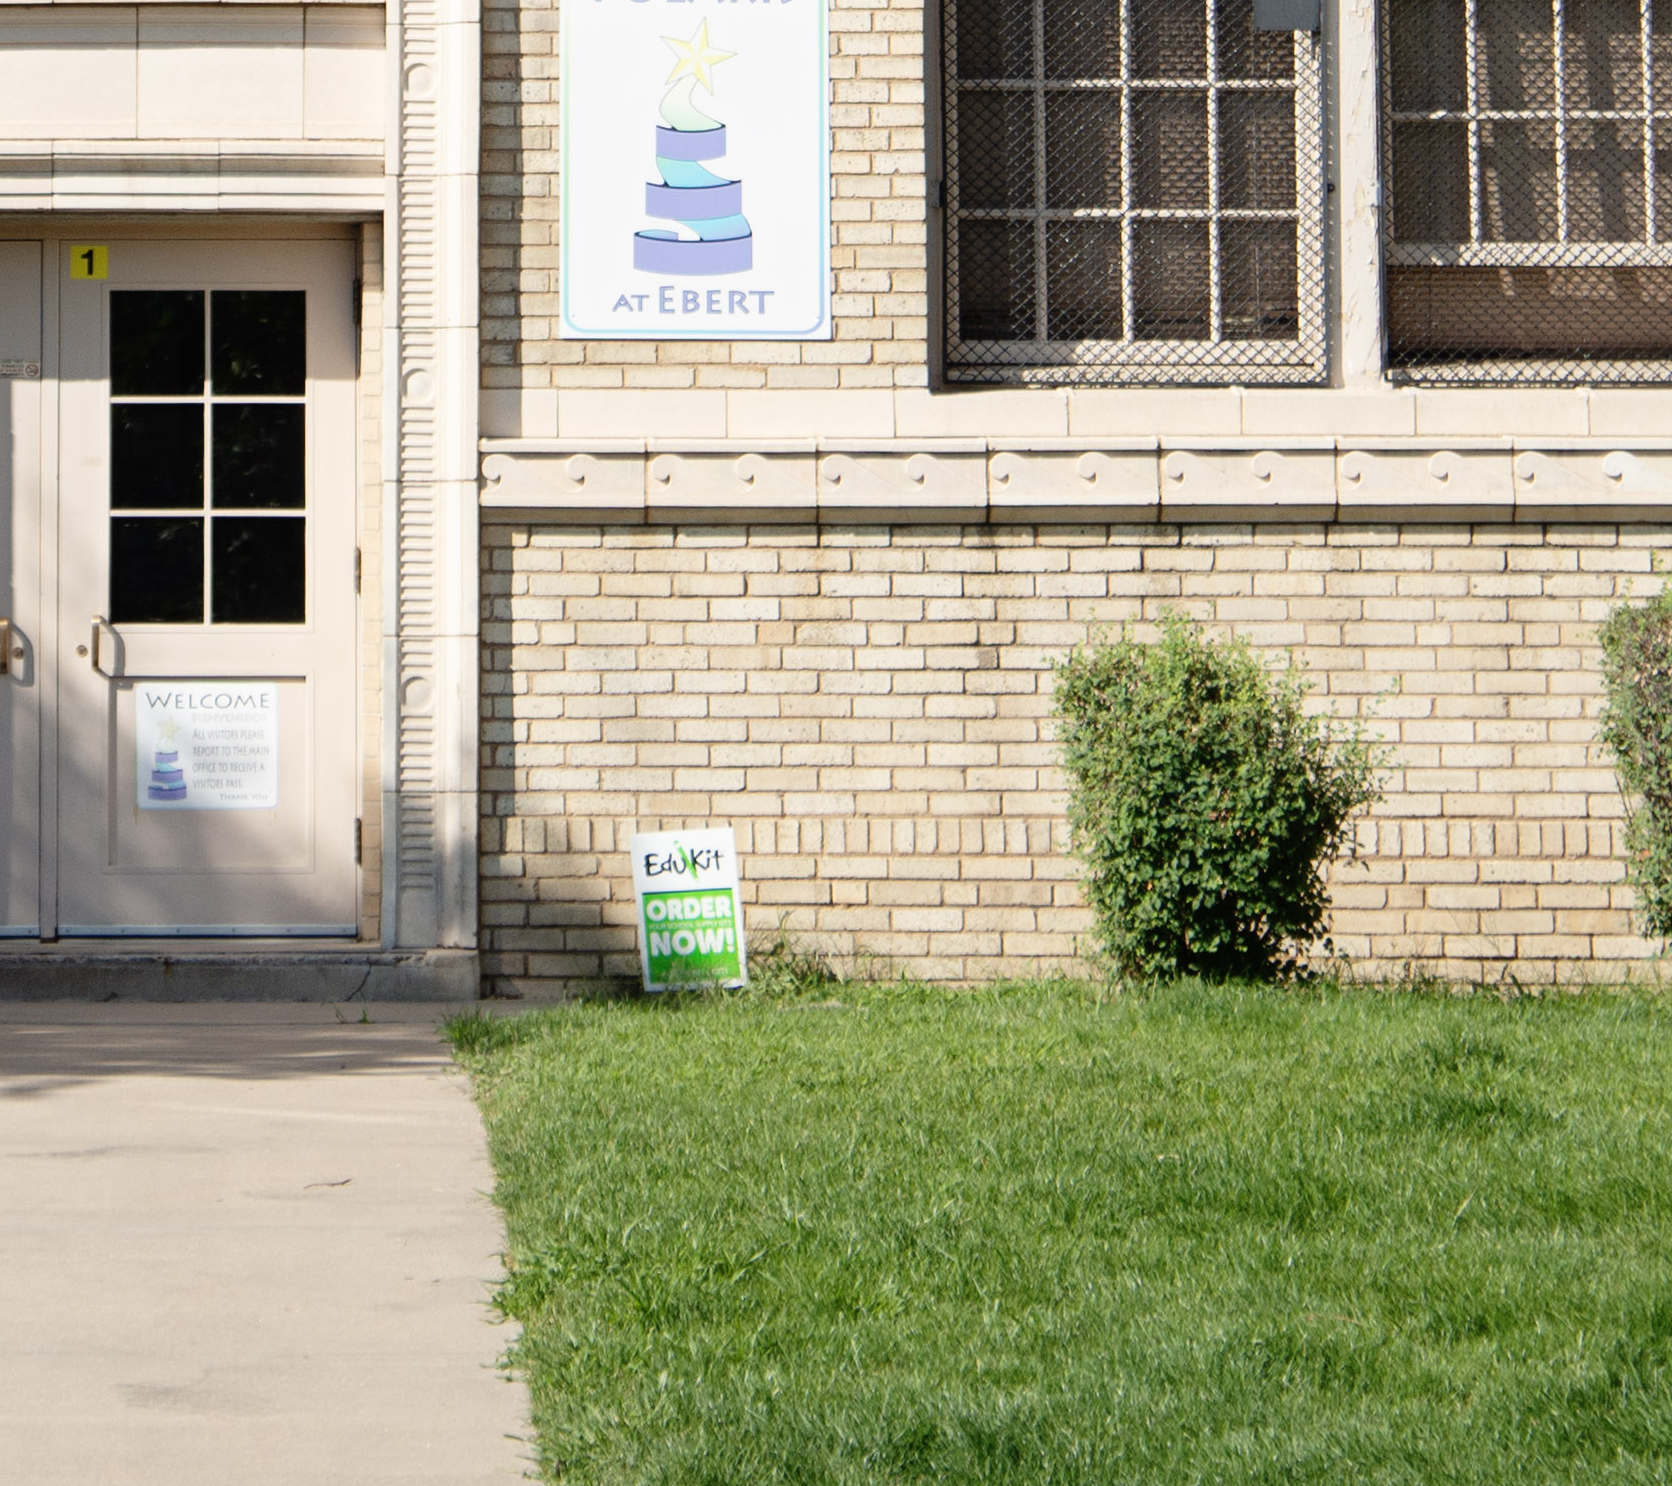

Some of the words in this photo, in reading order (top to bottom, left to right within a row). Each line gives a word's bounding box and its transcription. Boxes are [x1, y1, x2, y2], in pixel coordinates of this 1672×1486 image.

[81, 249, 94, 275] 1
[612, 293, 650, 314] AT
[658, 285, 775, 315] EBERT
[146, 692, 270, 710] WELCOME
[193, 729, 206, 740] ALL
[207, 729, 238, 740] VISITORS
[240, 729, 265, 740] PLEASE
[193, 746, 219, 757] REPORT
[221, 746, 231, 757] TO
[233, 746, 247, 757] THE
[249, 746, 270, 757] MAIN
[193, 762, 216, 773] OFFICE
[218, 762, 228, 773] TO
[230, 762, 257, 772] RECEIVE
[193, 778, 224, 789] VISITORS
[644, 848, 724, 877] EduKit
[646, 895, 732, 922] ORDER
[649, 928, 736, 958] NOW!
